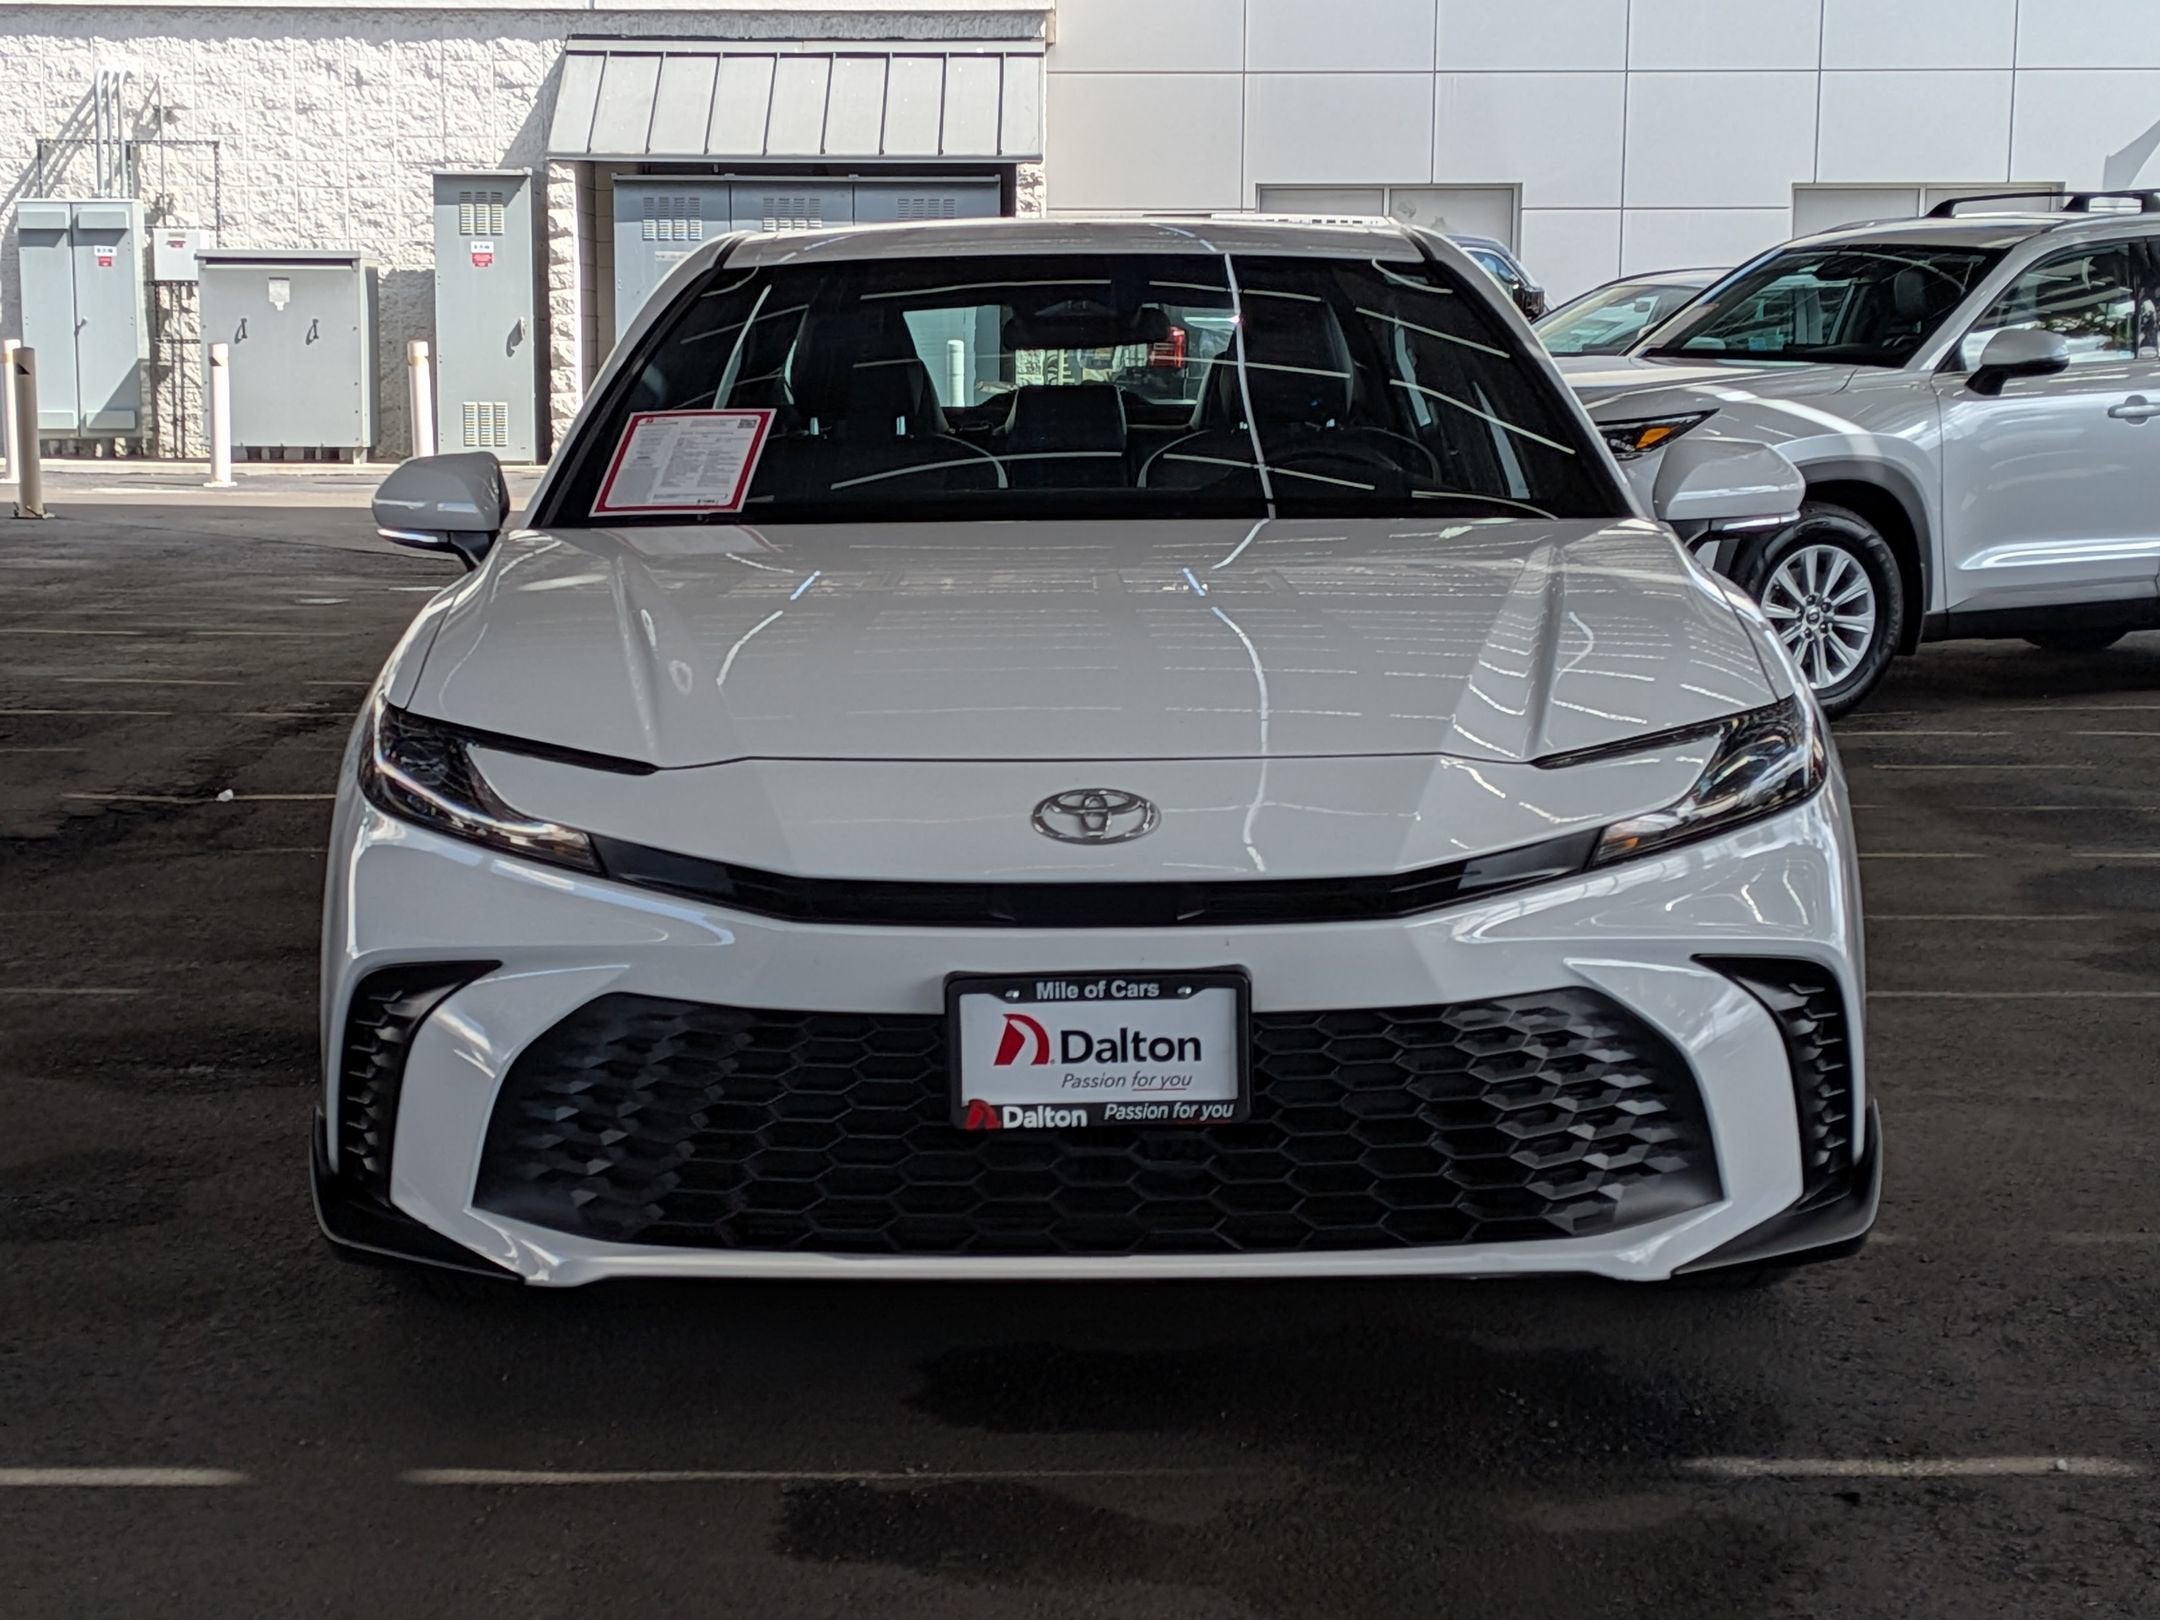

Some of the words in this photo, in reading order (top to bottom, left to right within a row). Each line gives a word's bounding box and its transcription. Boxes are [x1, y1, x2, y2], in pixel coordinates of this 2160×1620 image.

[1036, 981, 1079, 1000] Mile
[1084, 980, 1106, 998] of
[1110, 979, 1160, 998] Cars
[1060, 1027, 1202, 1065] Dalton
[1061, 1072, 1126, 1089] Passion
[1131, 1070, 1157, 1088] for
[1160, 1074, 1193, 1090] you
[1002, 1106, 1088, 1129] Dalton
[1104, 1104, 1168, 1121] Passion
[1172, 1102, 1199, 1119] for
[1199, 1102, 1234, 1121] you
